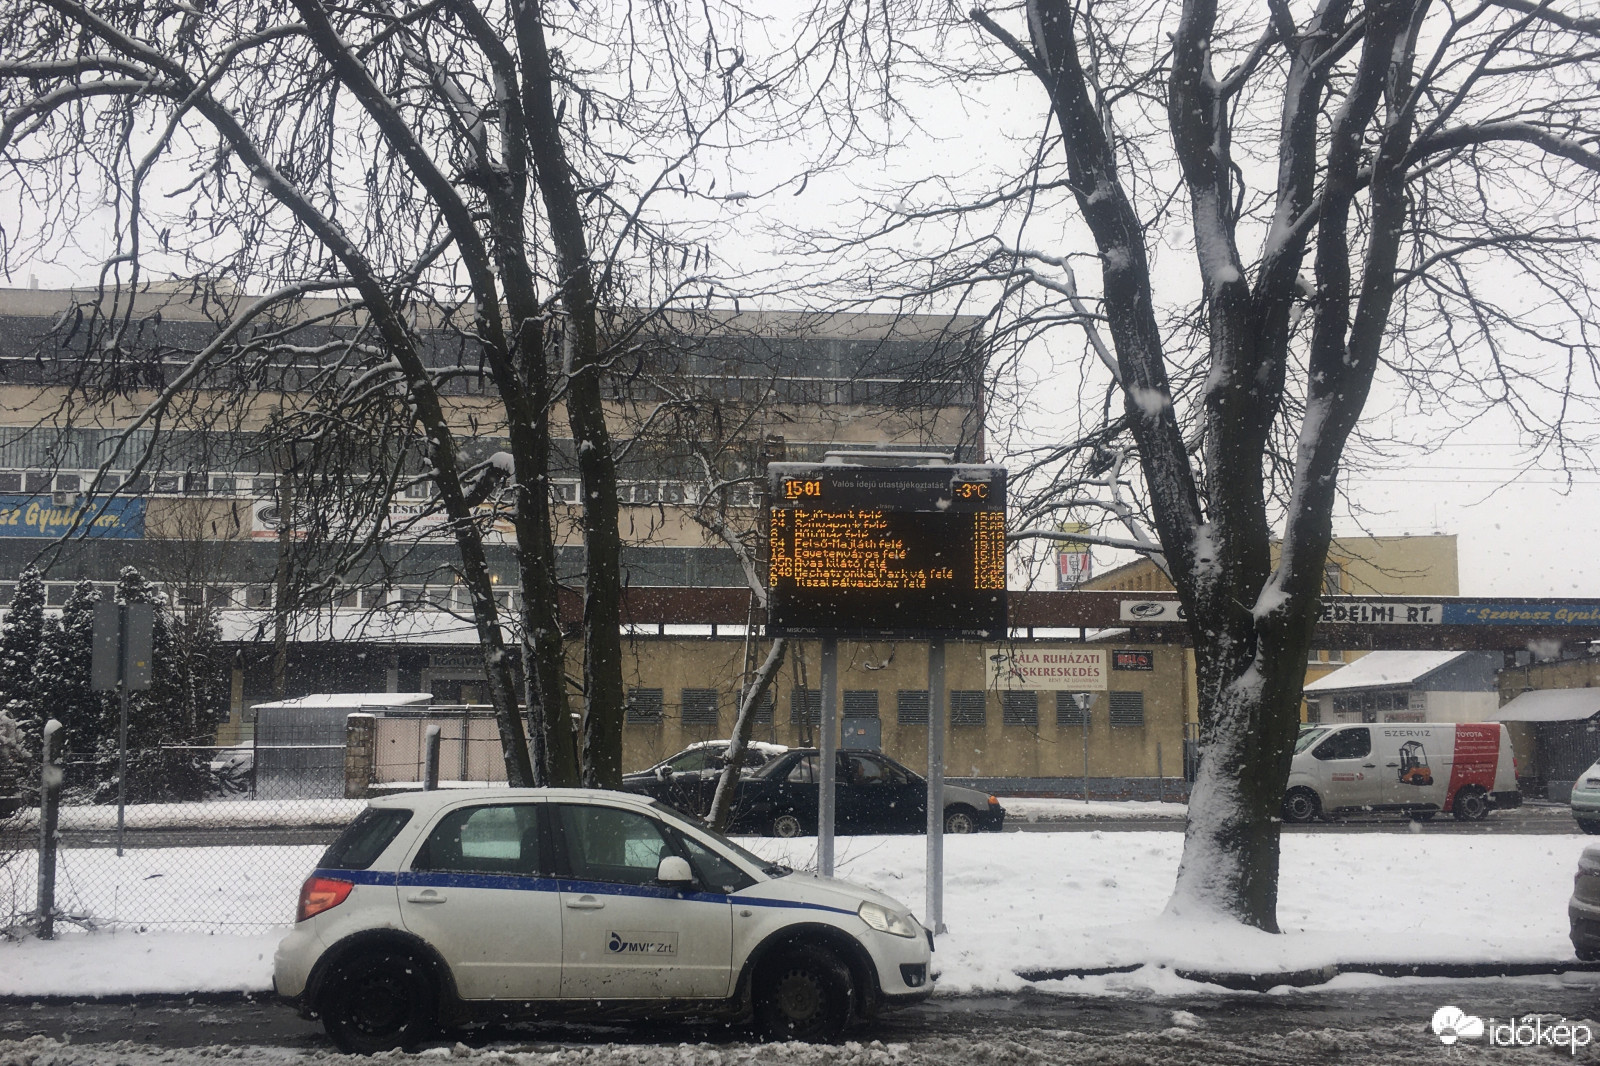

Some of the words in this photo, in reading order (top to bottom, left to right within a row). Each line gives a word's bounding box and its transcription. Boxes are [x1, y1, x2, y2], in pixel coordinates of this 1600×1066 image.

[832, 480, 854, 488] Valós
[878, 539, 903, 549] felé
[770, 548, 786, 558] 12
[795, 548, 880, 559] Egyetemváros
[883, 549, 907, 560] felé
[1322, 606, 1395, 622] EDELMI
[1407, 606, 1434, 622] RT.
[1554, 608, 1600, 623] Gyul
[1043, 652, 1100, 664] RUHÁZATI
[1010, 665, 1100, 677] KISKERESKEDÉS
[656, 943, 675, 953] Zrt.
